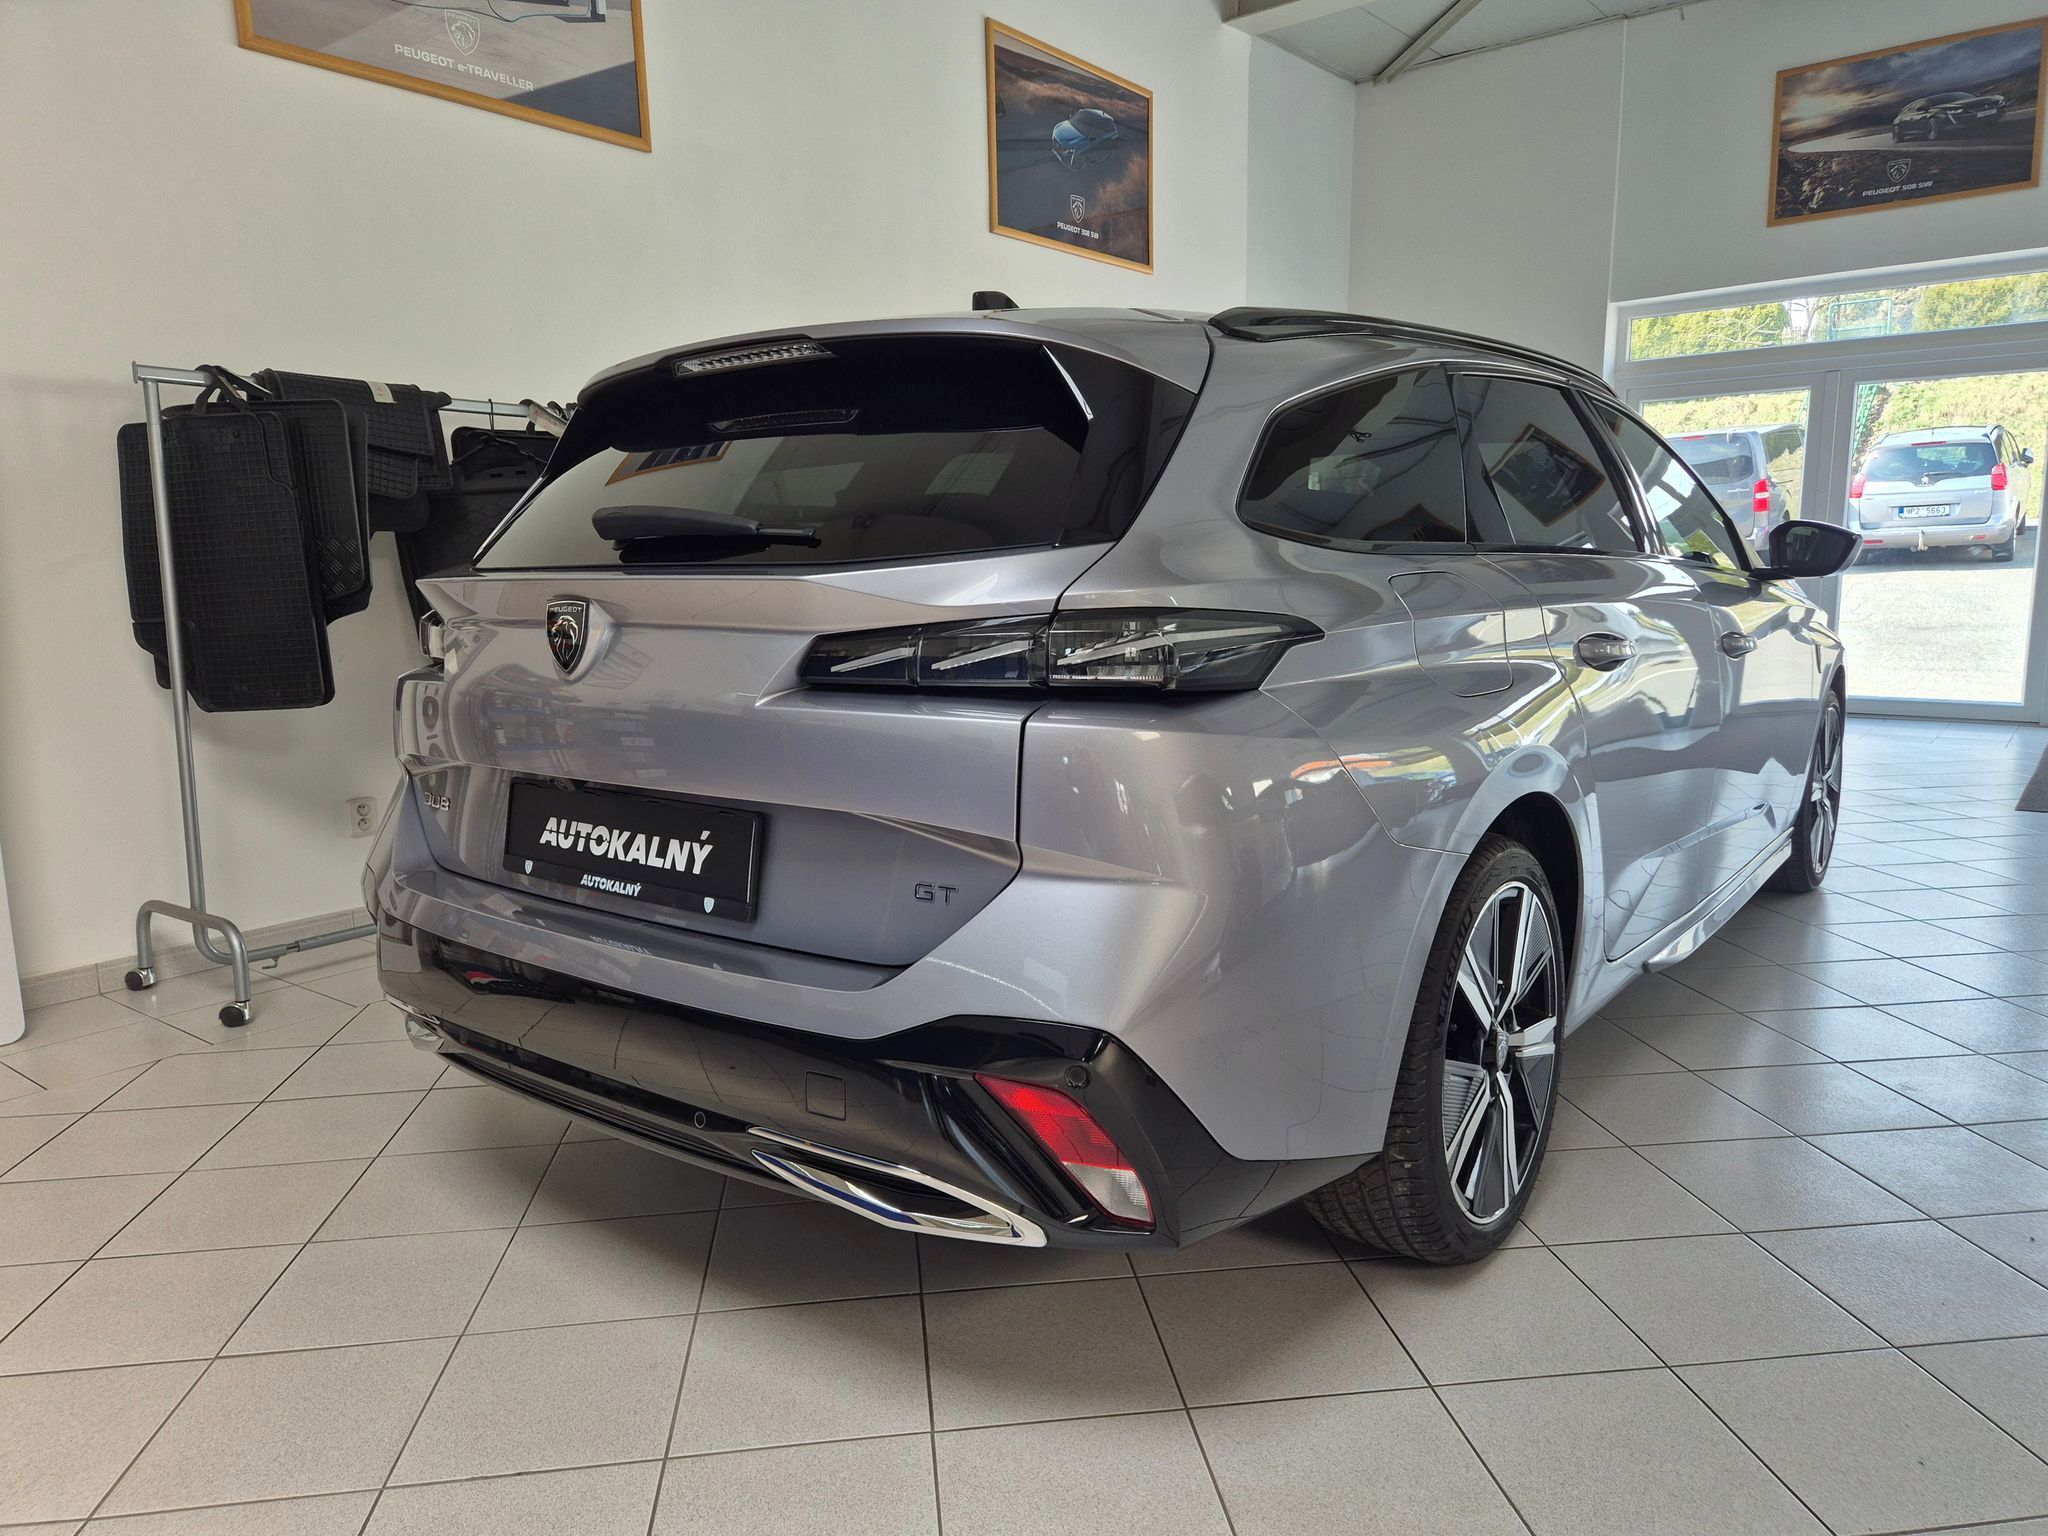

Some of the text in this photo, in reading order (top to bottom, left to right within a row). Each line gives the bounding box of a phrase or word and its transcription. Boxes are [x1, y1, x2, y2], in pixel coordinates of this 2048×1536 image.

[394, 44, 534, 92] PEUGEOT e-TRAVELLER
[1862, 181, 1934, 198] PEUGEOT 508 SW
[1056, 221, 1099, 240] PEUGEOT 308 SW
[549, 605, 582, 613] PEUGEOT
[539, 816, 713, 875] AUTOKALNÝ
[580, 873, 642, 897] AUTOKALNÝ
[914, 883, 959, 904] GT
